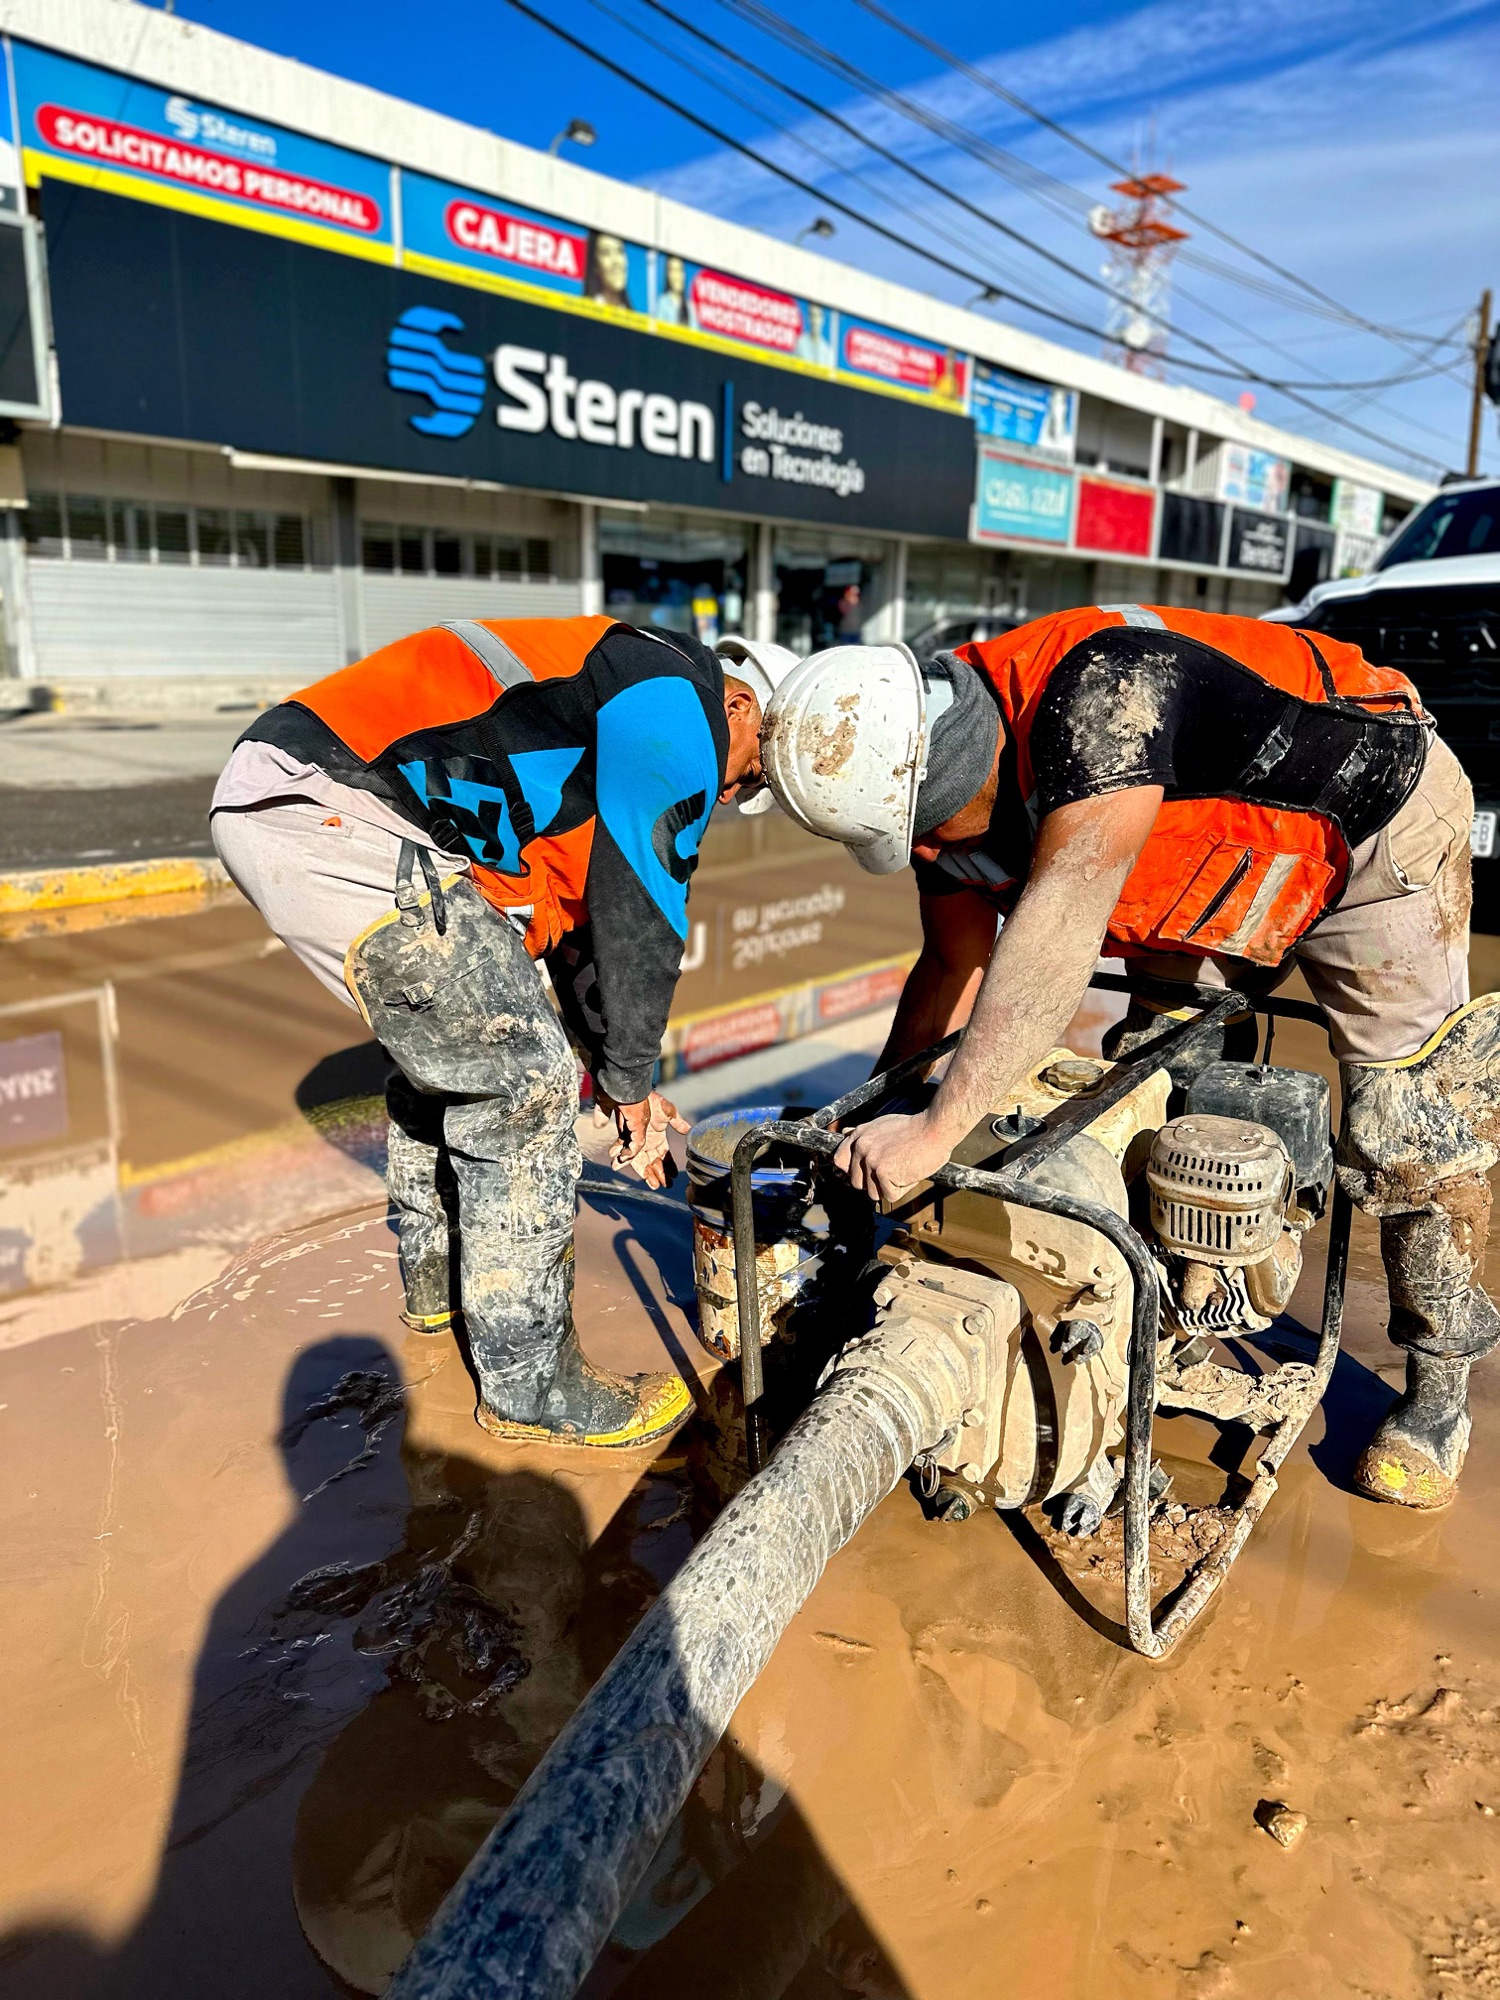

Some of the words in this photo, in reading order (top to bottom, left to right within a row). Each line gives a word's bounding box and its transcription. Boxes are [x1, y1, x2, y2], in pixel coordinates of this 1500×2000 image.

[201, 113, 277, 158] Steren
[54, 114, 242, 192] SOLICITAMOS
[243, 168, 371, 229] PERSONAL
[453, 206, 579, 277] CAJERA
[493, 343, 715, 463] Steren
[741, 401, 844, 454] Soluciones
[741, 446, 770, 477] en
